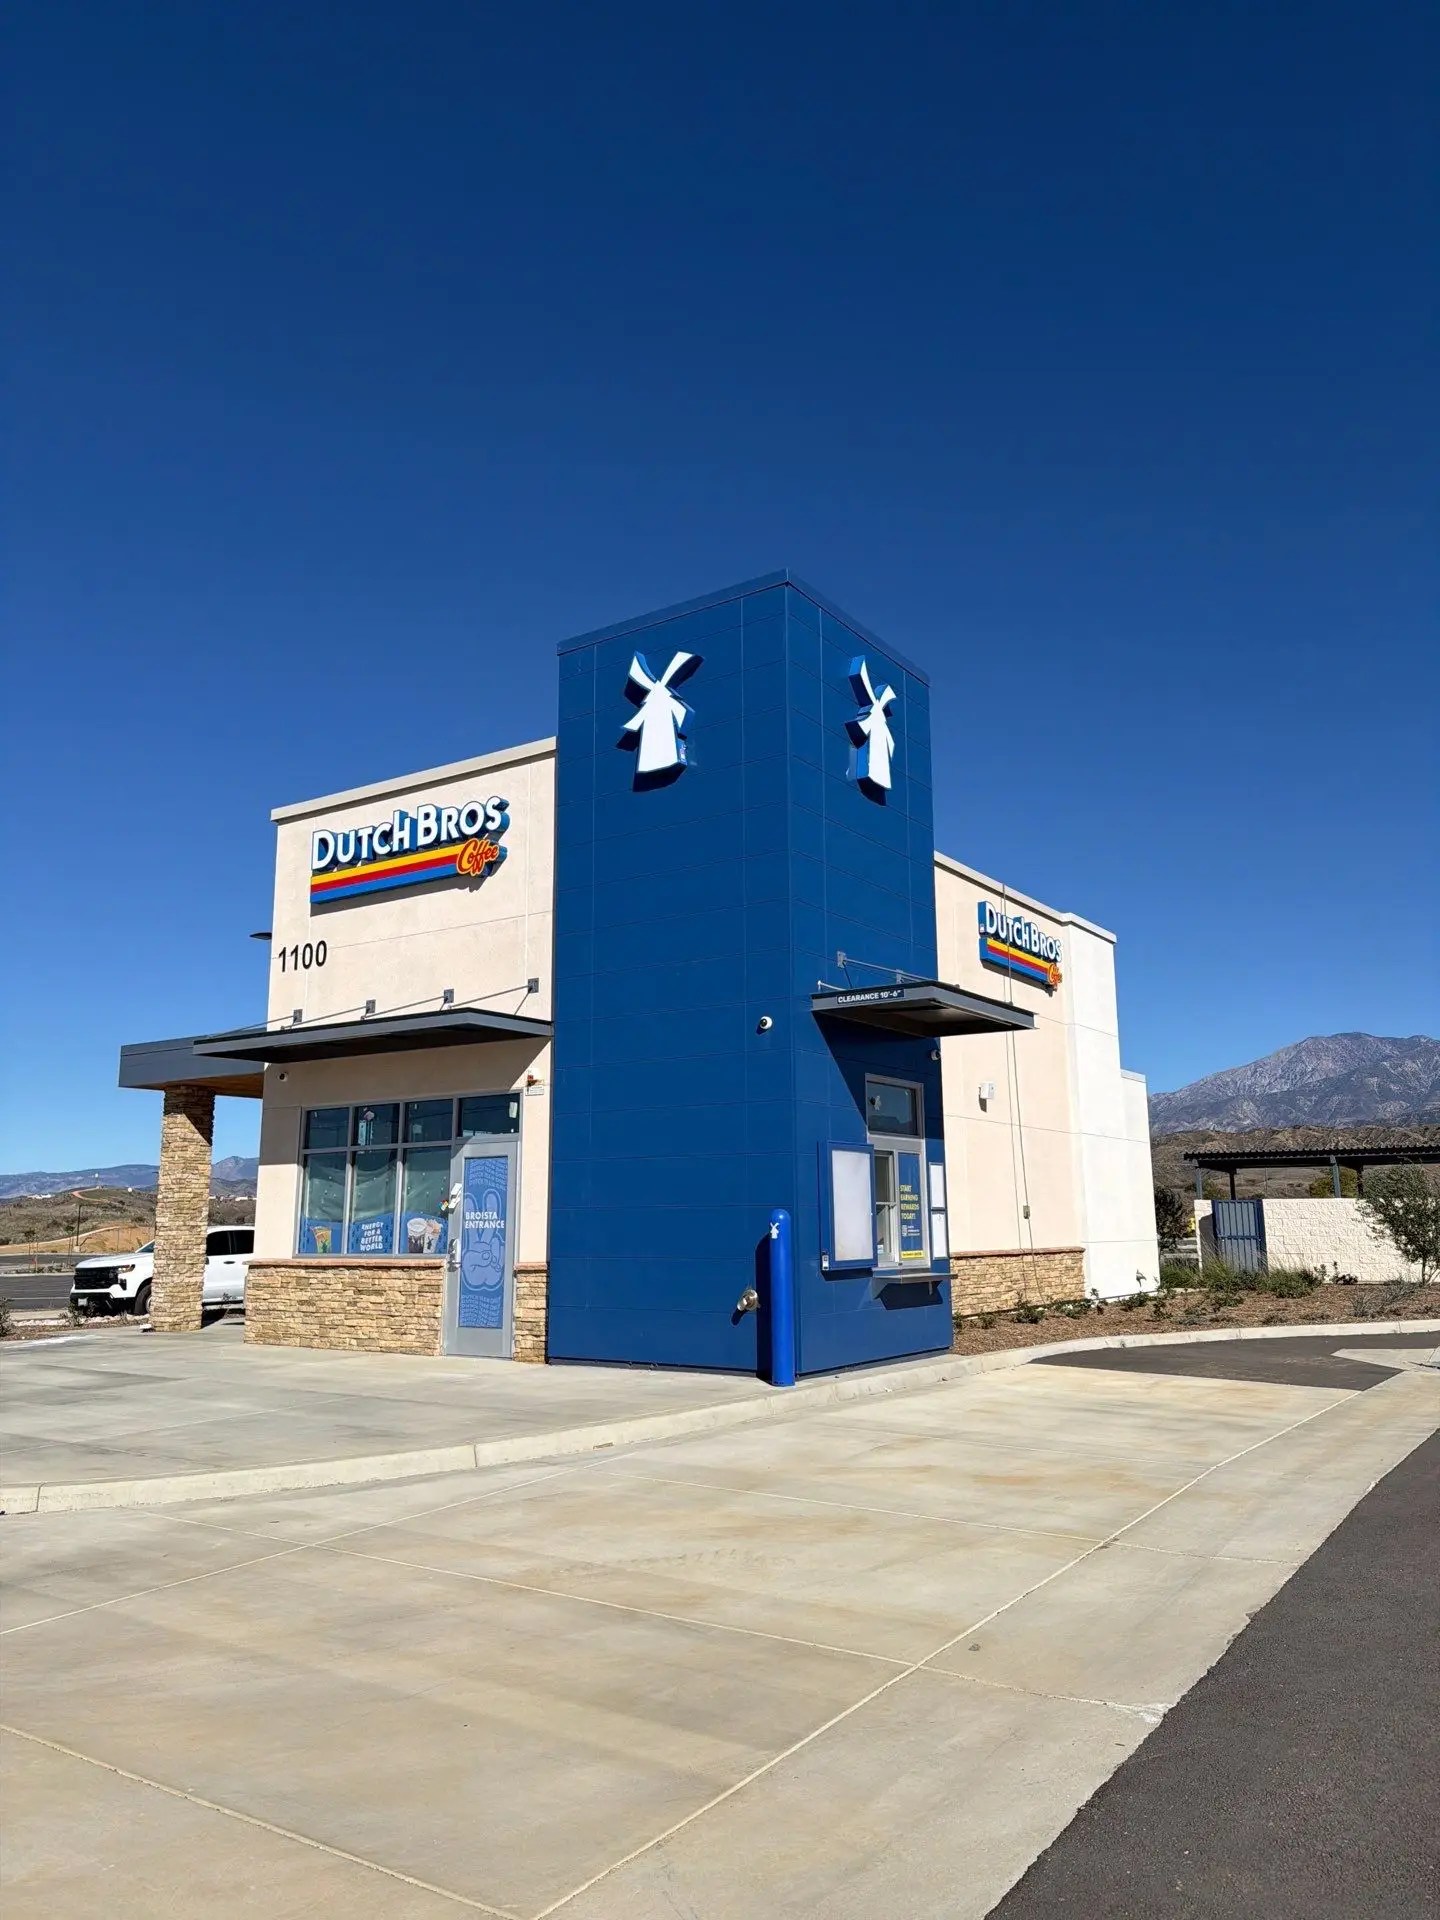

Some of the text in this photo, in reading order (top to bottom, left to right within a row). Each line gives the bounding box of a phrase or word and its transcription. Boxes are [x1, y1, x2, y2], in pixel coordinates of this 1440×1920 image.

[311, 796, 503, 869] DUTCH BROS
[457, 838, 500, 876] Coffee
[985, 901, 1062, 962] DUTCH BROS
[278, 940, 327, 972] 1100
[838, 992, 879, 1003] CLEARANCE
[465, 1211, 498, 1220] BROISTA
[361, 1221, 384, 1231] ENERGY
[464, 1220, 505, 1229] ENTRANCE
[360, 1235, 383, 1245] BETTER
[360, 1243, 384, 1252] WORLD
